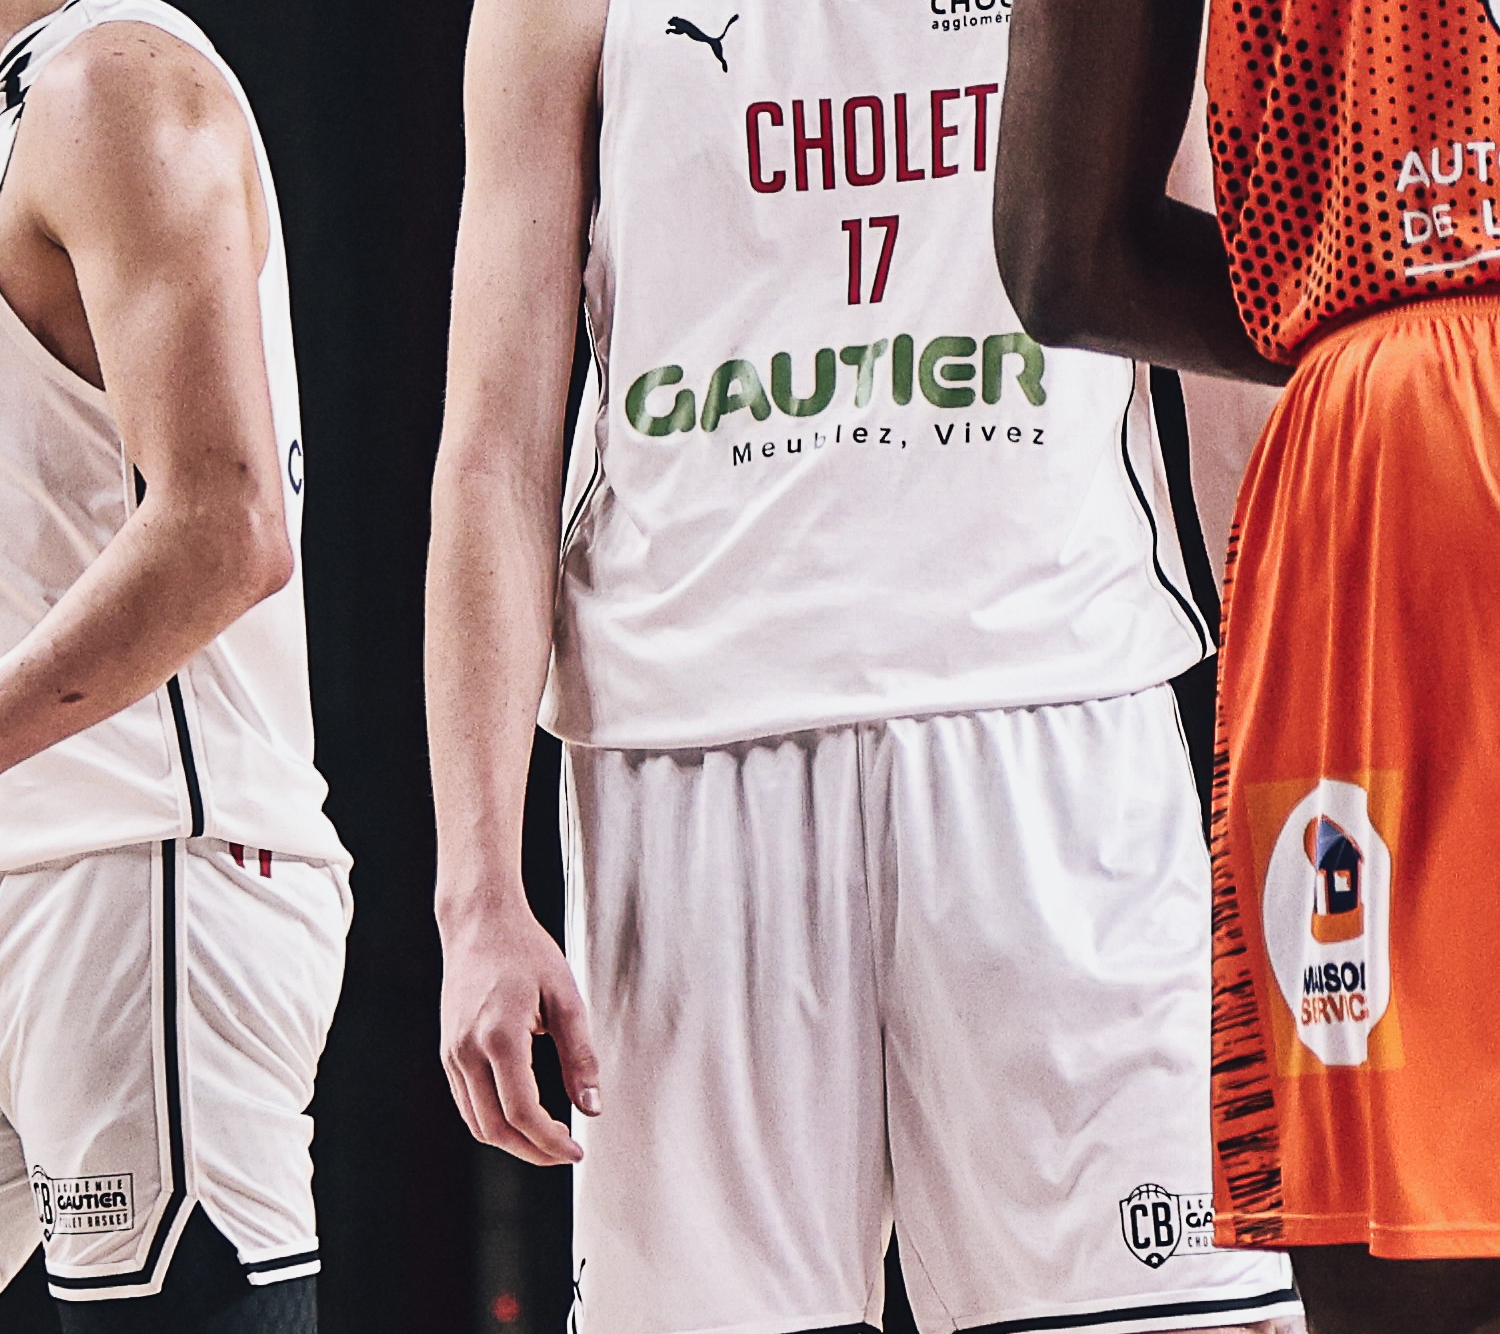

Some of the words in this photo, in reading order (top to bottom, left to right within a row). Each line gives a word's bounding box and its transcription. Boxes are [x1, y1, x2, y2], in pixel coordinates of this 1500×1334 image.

[932, 11, 1012, 32] agglomér
[745, 82, 999, 194] CHOLET
[1404, 208, 1452, 246] DE
[841, 215, 899, 305] 17
[625, 331, 1047, 437] GAUTIER
[934, 422, 1046, 446] Vivez
[57, 1191, 127, 1211] GAUTIER
[1130, 1201, 1174, 1249] CB
